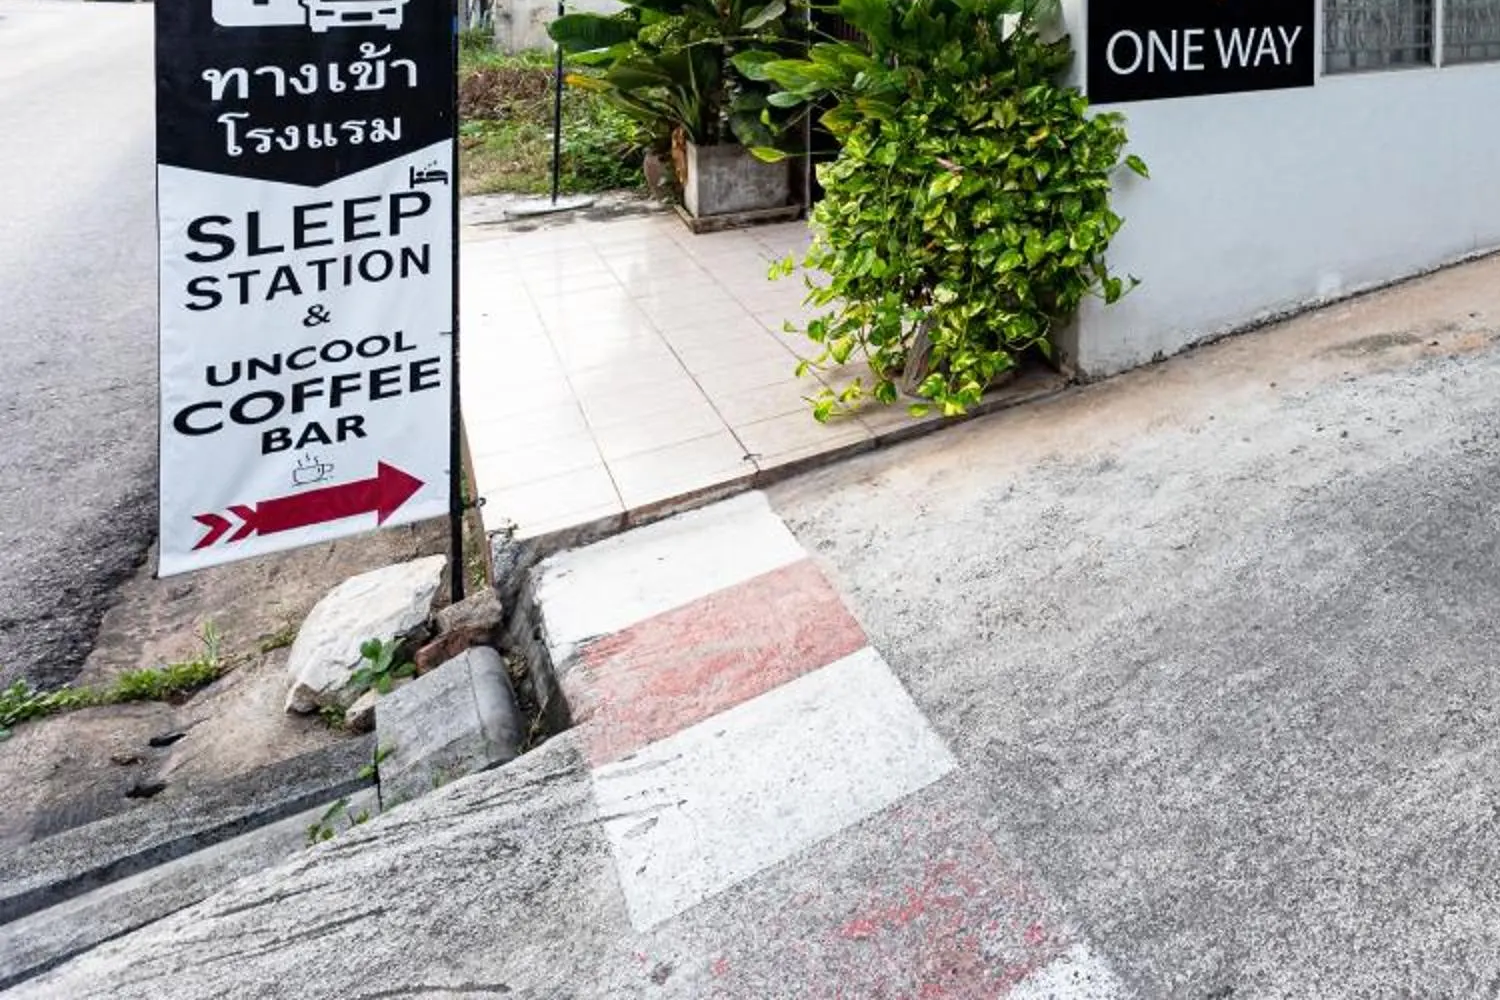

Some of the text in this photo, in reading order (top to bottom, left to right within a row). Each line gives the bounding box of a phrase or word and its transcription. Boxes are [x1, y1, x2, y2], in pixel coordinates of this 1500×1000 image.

[202, 41, 418, 101] ทางเข้า
[1106, 25, 1302, 76] ONE WAY
[217, 112, 401, 157] โรงแรม
[184, 191, 433, 263] SLEEP
[185, 243, 430, 311] STATION
[303, 303, 331, 327] &
[205, 330, 417, 387] UNCOOL
[172, 355, 441, 436] COFFEE
[261, 414, 367, 455] BAR
